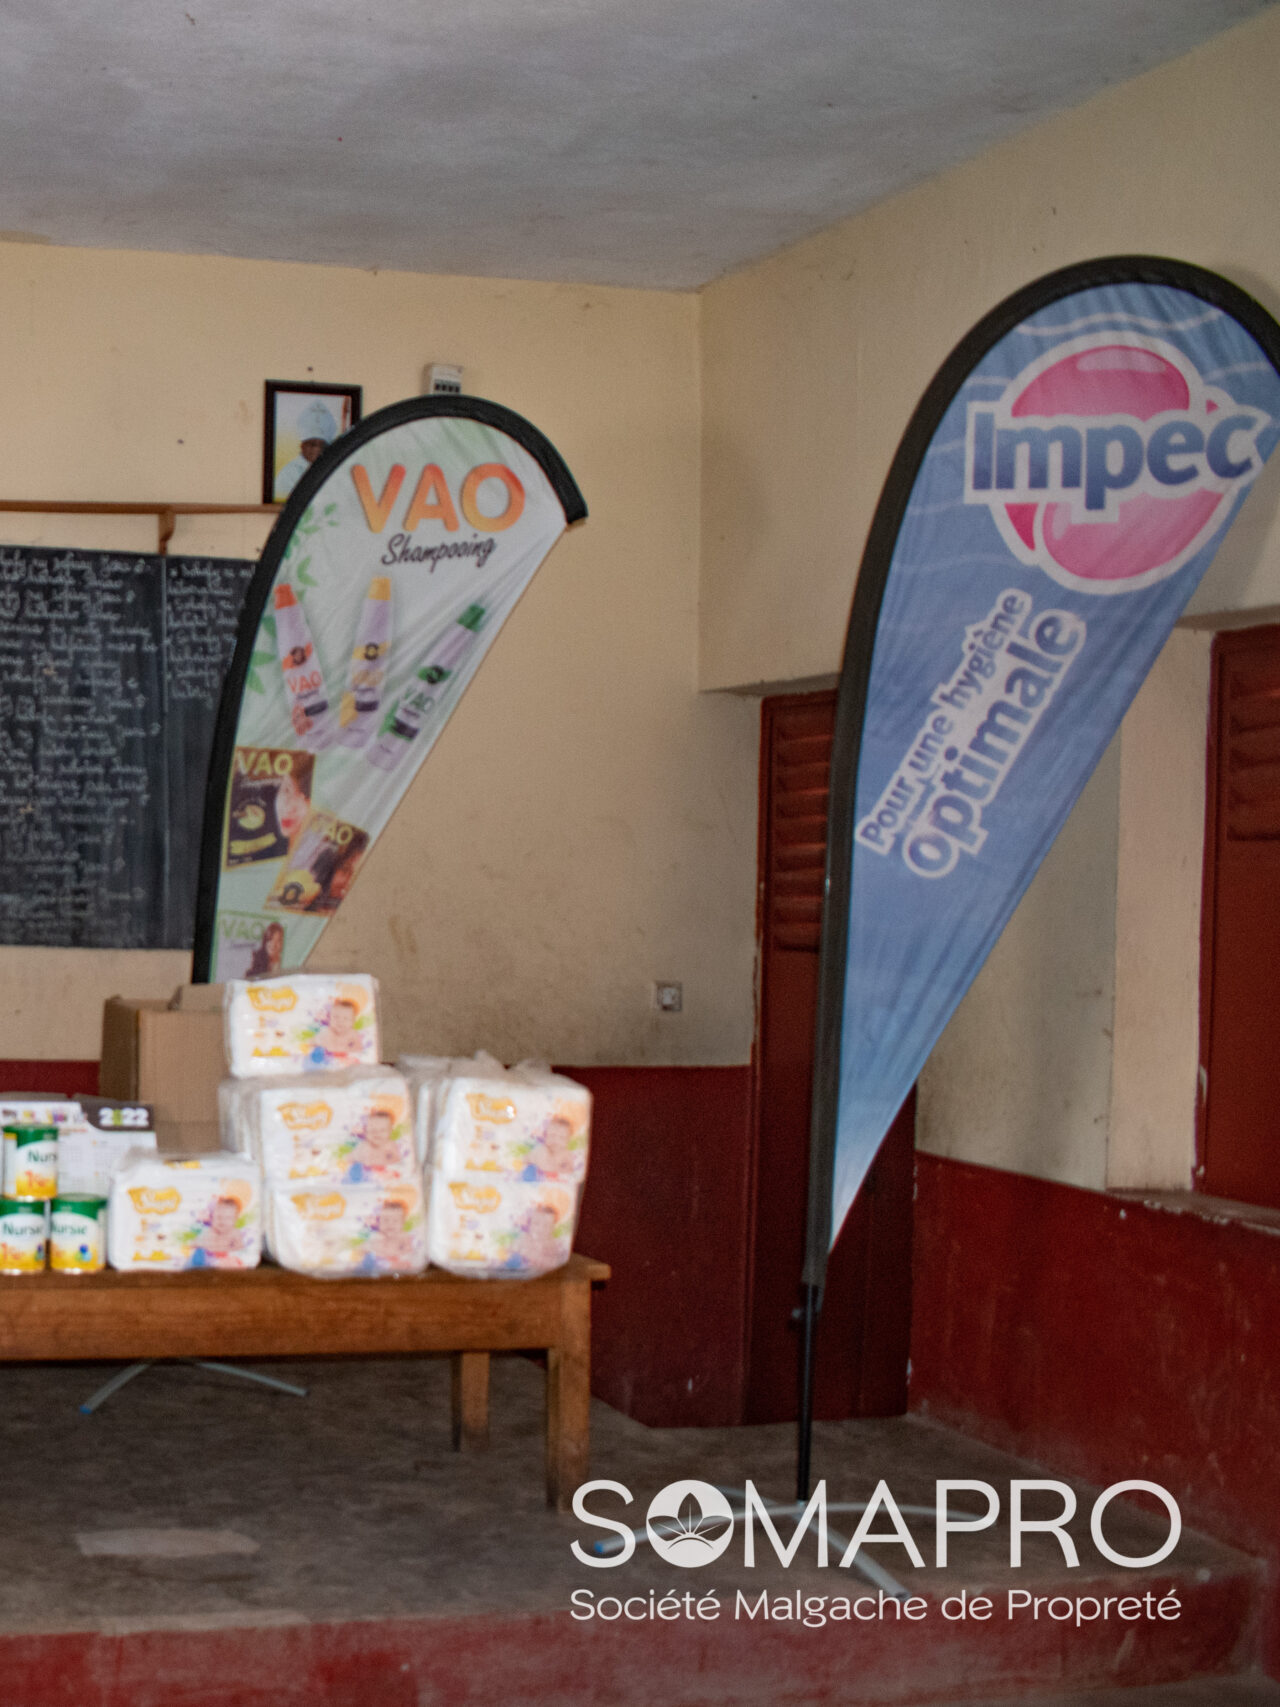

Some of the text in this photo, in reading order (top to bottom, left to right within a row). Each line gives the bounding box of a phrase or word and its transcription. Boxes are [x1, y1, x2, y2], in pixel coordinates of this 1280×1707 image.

[972, 408, 1259, 511] Impec
[351, 463, 526, 533] VAO
[381, 534, 496, 575] Shampooing
[859, 592, 1024, 848] Pour une hygiène
[908, 614, 1078, 866] optimale
[237, 751, 293, 776] VAO
[28, 1150, 58, 1163] Nurs
